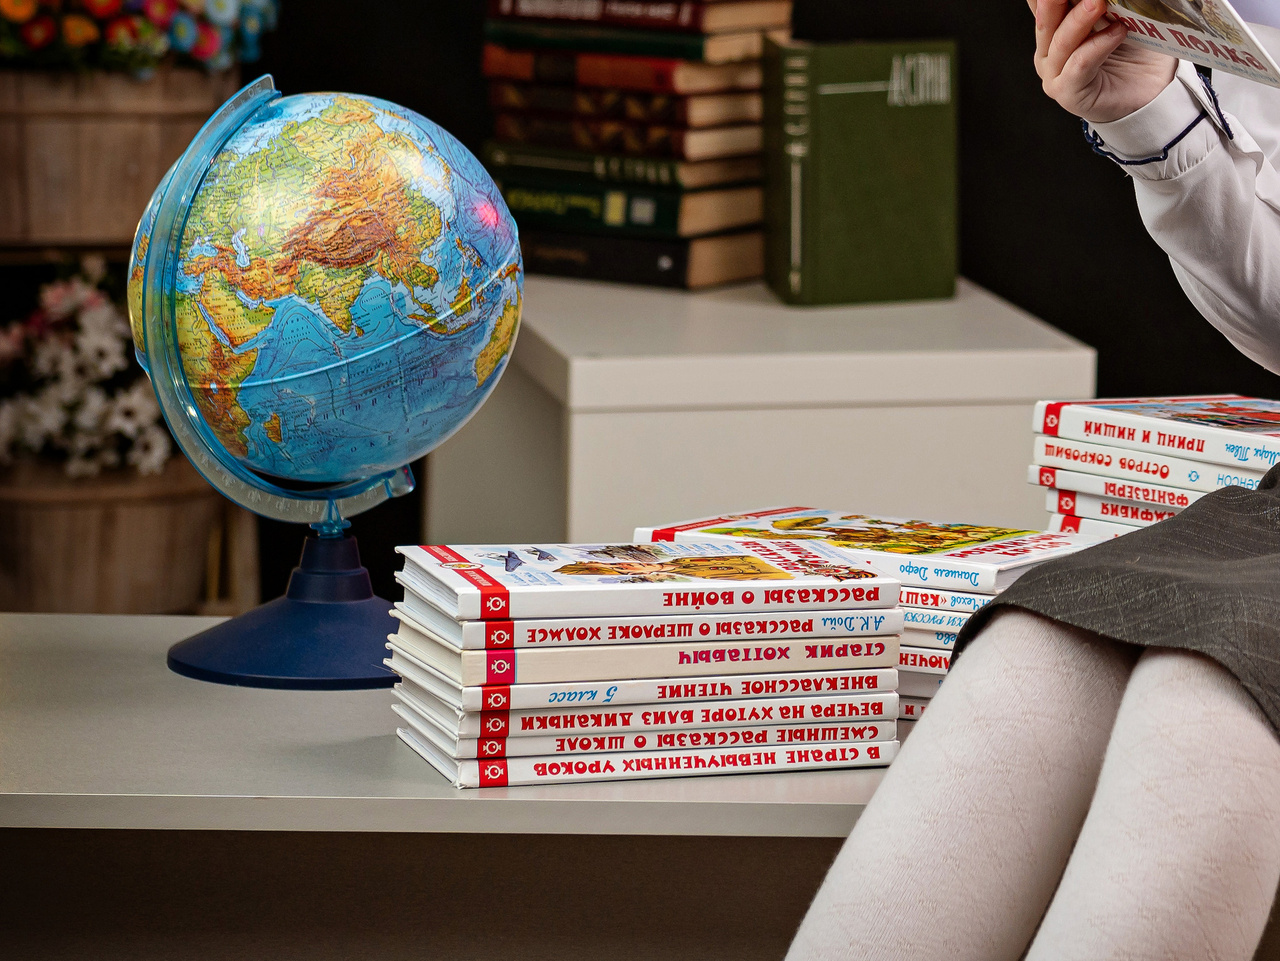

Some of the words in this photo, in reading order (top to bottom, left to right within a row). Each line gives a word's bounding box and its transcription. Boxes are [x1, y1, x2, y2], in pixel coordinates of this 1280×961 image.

[1166, 28, 1268, 72] ПОЛКА
[1084, 421, 1136, 440] НИЩИЙ
[1142, 430, 1151, 443] И
[1158, 432, 1205, 452] ПРИНЦ
[1045, 444, 1112, 467] СОКРОВИЩ
[1225, 444, 1250, 461] Твен
[1254, 445, 1280, 466] Марк
[1119, 458, 1169, 479] ОСТРОВ
[899, 561, 928, 581] Дефо
[934, 568, 979, 587] Даниель
[663, 591, 734, 610] ВОЙНЕ
[742, 591, 754, 604] О
[764, 587, 879, 604] РАССКАЗЫ
[527, 627, 601, 643] ХОЛМСЕ
[608, 623, 693, 640] ШЕРЛОКЕ
[699, 623, 710, 636] О
[716, 619, 813, 635] РАССКАЗЫ
[936, 632, 957, 645] ева
[679, 647, 789, 664] ХОТТАБЫЧ
[805, 642, 884, 658] СТАРИК
[658, 683, 732, 699] ЧТЕНИЕ
[742, 676, 877, 694] ВНЕКЛАССНОЕ
[549, 690, 598, 702] класс
[603, 686, 617, 702] 5
[641, 710, 693, 725] БЛИЗ
[701, 707, 773, 723] ХУТОРЕ
[779, 705, 804, 719] НА
[811, 702, 883, 717] ВЕЧЕРА
[521, 712, 633, 730] ДИКАНЬКИ
[634, 735, 646, 748] О
[657, 730, 767, 747] РАССКАЗЫ
[777, 726, 878, 742] СМЕШНЫЕ
[556, 736, 624, 751] ШКОЛЕ
[786, 748, 859, 763] СТРАНЕ
[867, 746, 880, 759] В
[534, 760, 615, 776] УРОКОВ
[623, 752, 776, 772] НЕВЫУЧЕННЫХ
